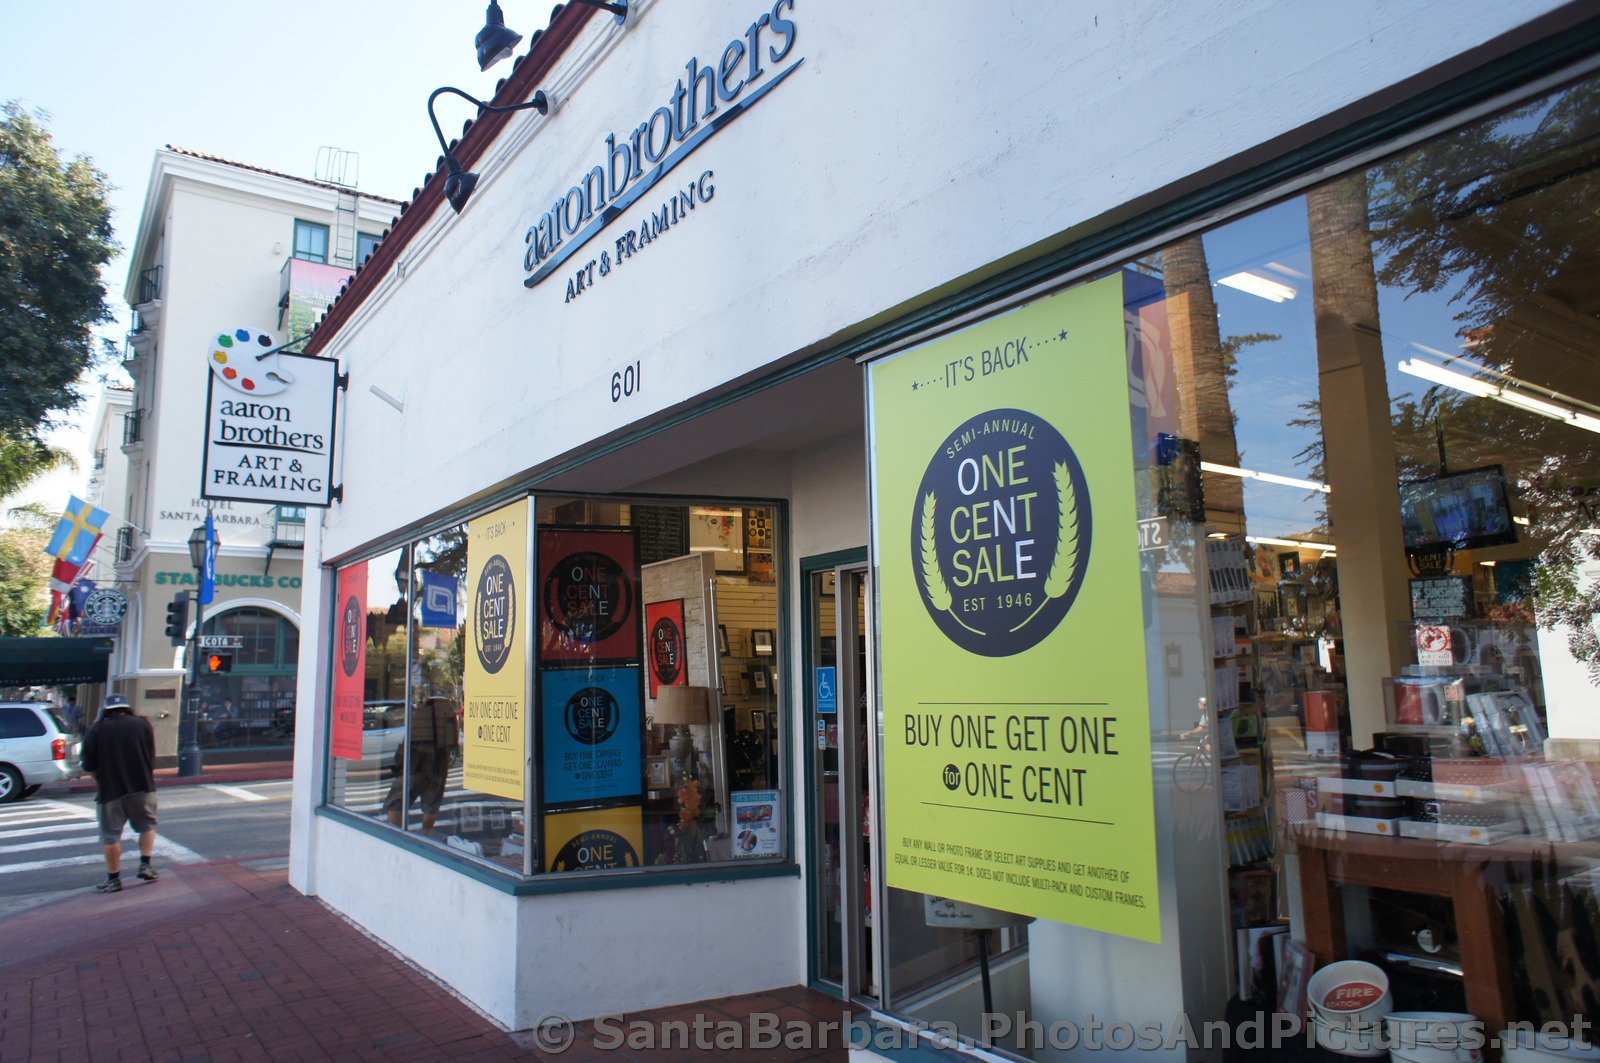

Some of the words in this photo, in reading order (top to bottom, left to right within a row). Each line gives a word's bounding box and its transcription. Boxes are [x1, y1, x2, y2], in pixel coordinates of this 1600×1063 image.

[565, 259, 596, 303] ART
[598, 250, 611, 278] &
[615, 170, 715, 266] FRAMING
[945, 355, 975, 388] IT'S
[981, 336, 1029, 377] BACK
[611, 360, 641, 403] 601
[220, 400, 291, 422] aaron
[220, 420, 324, 450] brothers
[946, 418, 1036, 459] SEMI-ANNUAL
[237, 455, 282, 472] ART
[289, 458, 303, 473] &
[957, 444, 1029, 496] ONE
[213, 469, 322, 493] FRAMING
[191, 498, 234, 510] HOTEL
[160, 510, 200, 521] SANTA
[212, 514, 260, 526] ARBARA
[950, 491, 1038, 544] CENT
[495, 521, 507, 538] BACK
[952, 538, 1037, 587] SALE
[155, 572, 274, 588] STABUCKS
[571, 566, 606, 582] ONE
[486, 573, 504, 595] ONE
[566, 584, 610, 599] CENT
[87, 589, 127, 605] STARBUCKS
[963, 597, 986, 612] EST
[997, 592, 1033, 610] 1946
[483, 596, 505, 619] CENT
[567, 600, 609, 616] SALE
[91, 613, 121, 623] COFFEE
[483, 618, 504, 640] SALE
[658, 627, 672, 640] ONE
[205, 637, 228, 646] COTA
[658, 641, 673, 653] CENT
[658, 653, 675, 665] SALE
[580, 696, 604, 707] ONE
[469, 701, 479, 718] BUY
[480, 701, 492, 719] ONE
[493, 701, 504, 719] GET
[505, 701, 518, 720] ONE
[577, 707, 606, 719] CENT
[578, 717, 605, 729] SALE
[482, 724, 495, 742] ONE
[496, 724, 511, 743] CENT
[905, 713, 942, 747] BUY
[950, 714, 998, 750] ONE
[1006, 715, 1050, 752] GET
[1060, 715, 1119, 756] ONE
[564, 752, 577, 761] BUY
[580, 751, 594, 760] ONE
[595, 748, 621, 758] CANVAS
[563, 762, 577, 772] GET
[578, 761, 593, 771] ONE
[596, 758, 623, 769] CANVAS
[581, 771, 596, 781] ONE
[597, 770, 614, 780] CENT
[943, 766, 961, 786] for
[965, 761, 1014, 800] ONE
[1022, 765, 1087, 807] CENT
[571, 832, 617, 849] SEMI-ANNUAL
[577, 844, 614, 864] ONE
[902, 837, 912, 848] BUY
[913, 838, 923, 849] ANY
[923, 840, 936, 852] WALL
[938, 842, 945, 853] OR
[946, 843, 964, 857] PHOTO
[964, 846, 983, 860] FRAME
[984, 849, 993, 861] OR
[993, 851, 1014, 865] SELECT
[1015, 854, 1026, 866] ART
[1027, 856, 1056, 872] SUPPLIES
[1057, 861, 1071, 874] AND
[1073, 863, 1086, 876] GET
[1087, 866, 1119, 882] ANOTHER
[1120, 870, 1130, 884] OF
[894, 853, 910, 865] EQUAL
[910, 855, 917, 866] OR
[918, 857, 937, 870] LESSER
[938, 860, 954, 873] VALUE
[954, 863, 966, 875] FOR
[976, 867, 991, 880] DOES
[992, 870, 1005, 882] NOT
[1005, 872, 1031, 888] INCLUDE
[1032, 877, 1068, 894] MULTI-PACK
[1069, 883, 1083, 897] AND
[1085, 885, 1113, 903] CUSTOM
[1115, 891, 1146, 909] FRAMES.
[1336, 987, 1374, 1000] FIRE
[1326, 1000, 1361, 1008] STATION
